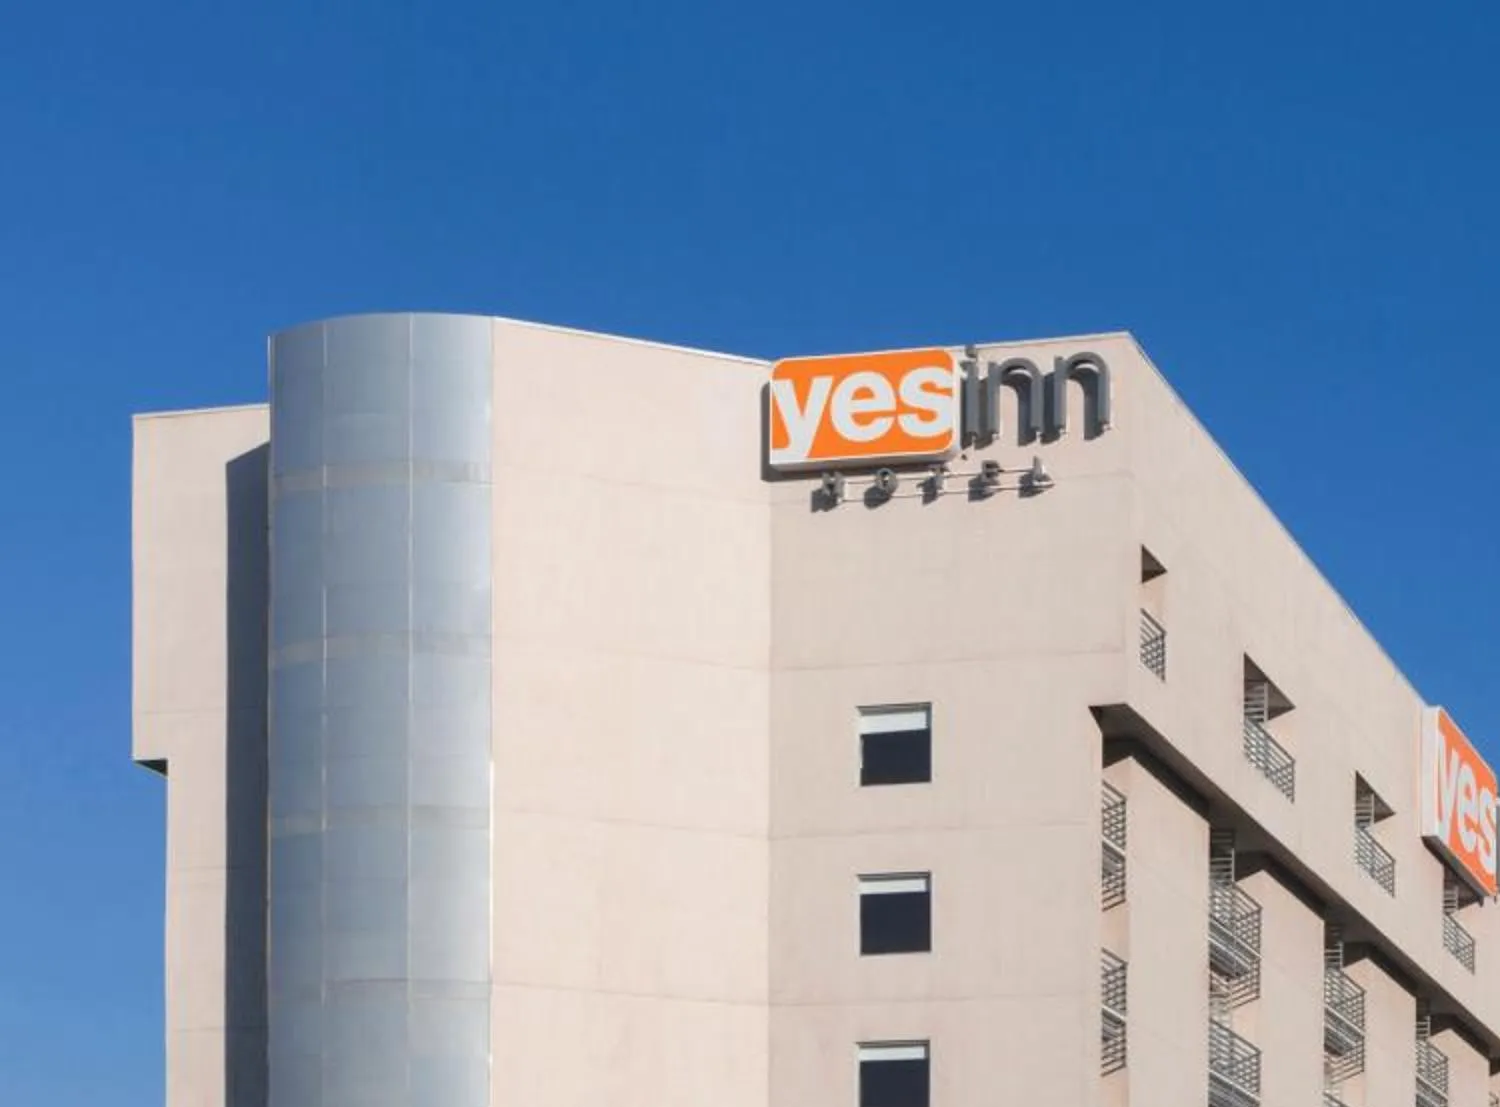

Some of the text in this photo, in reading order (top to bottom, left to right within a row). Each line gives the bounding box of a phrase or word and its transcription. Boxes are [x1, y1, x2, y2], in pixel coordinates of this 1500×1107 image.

[770, 345, 1111, 464] yes inn
[1435, 730, 1498, 876] yes
